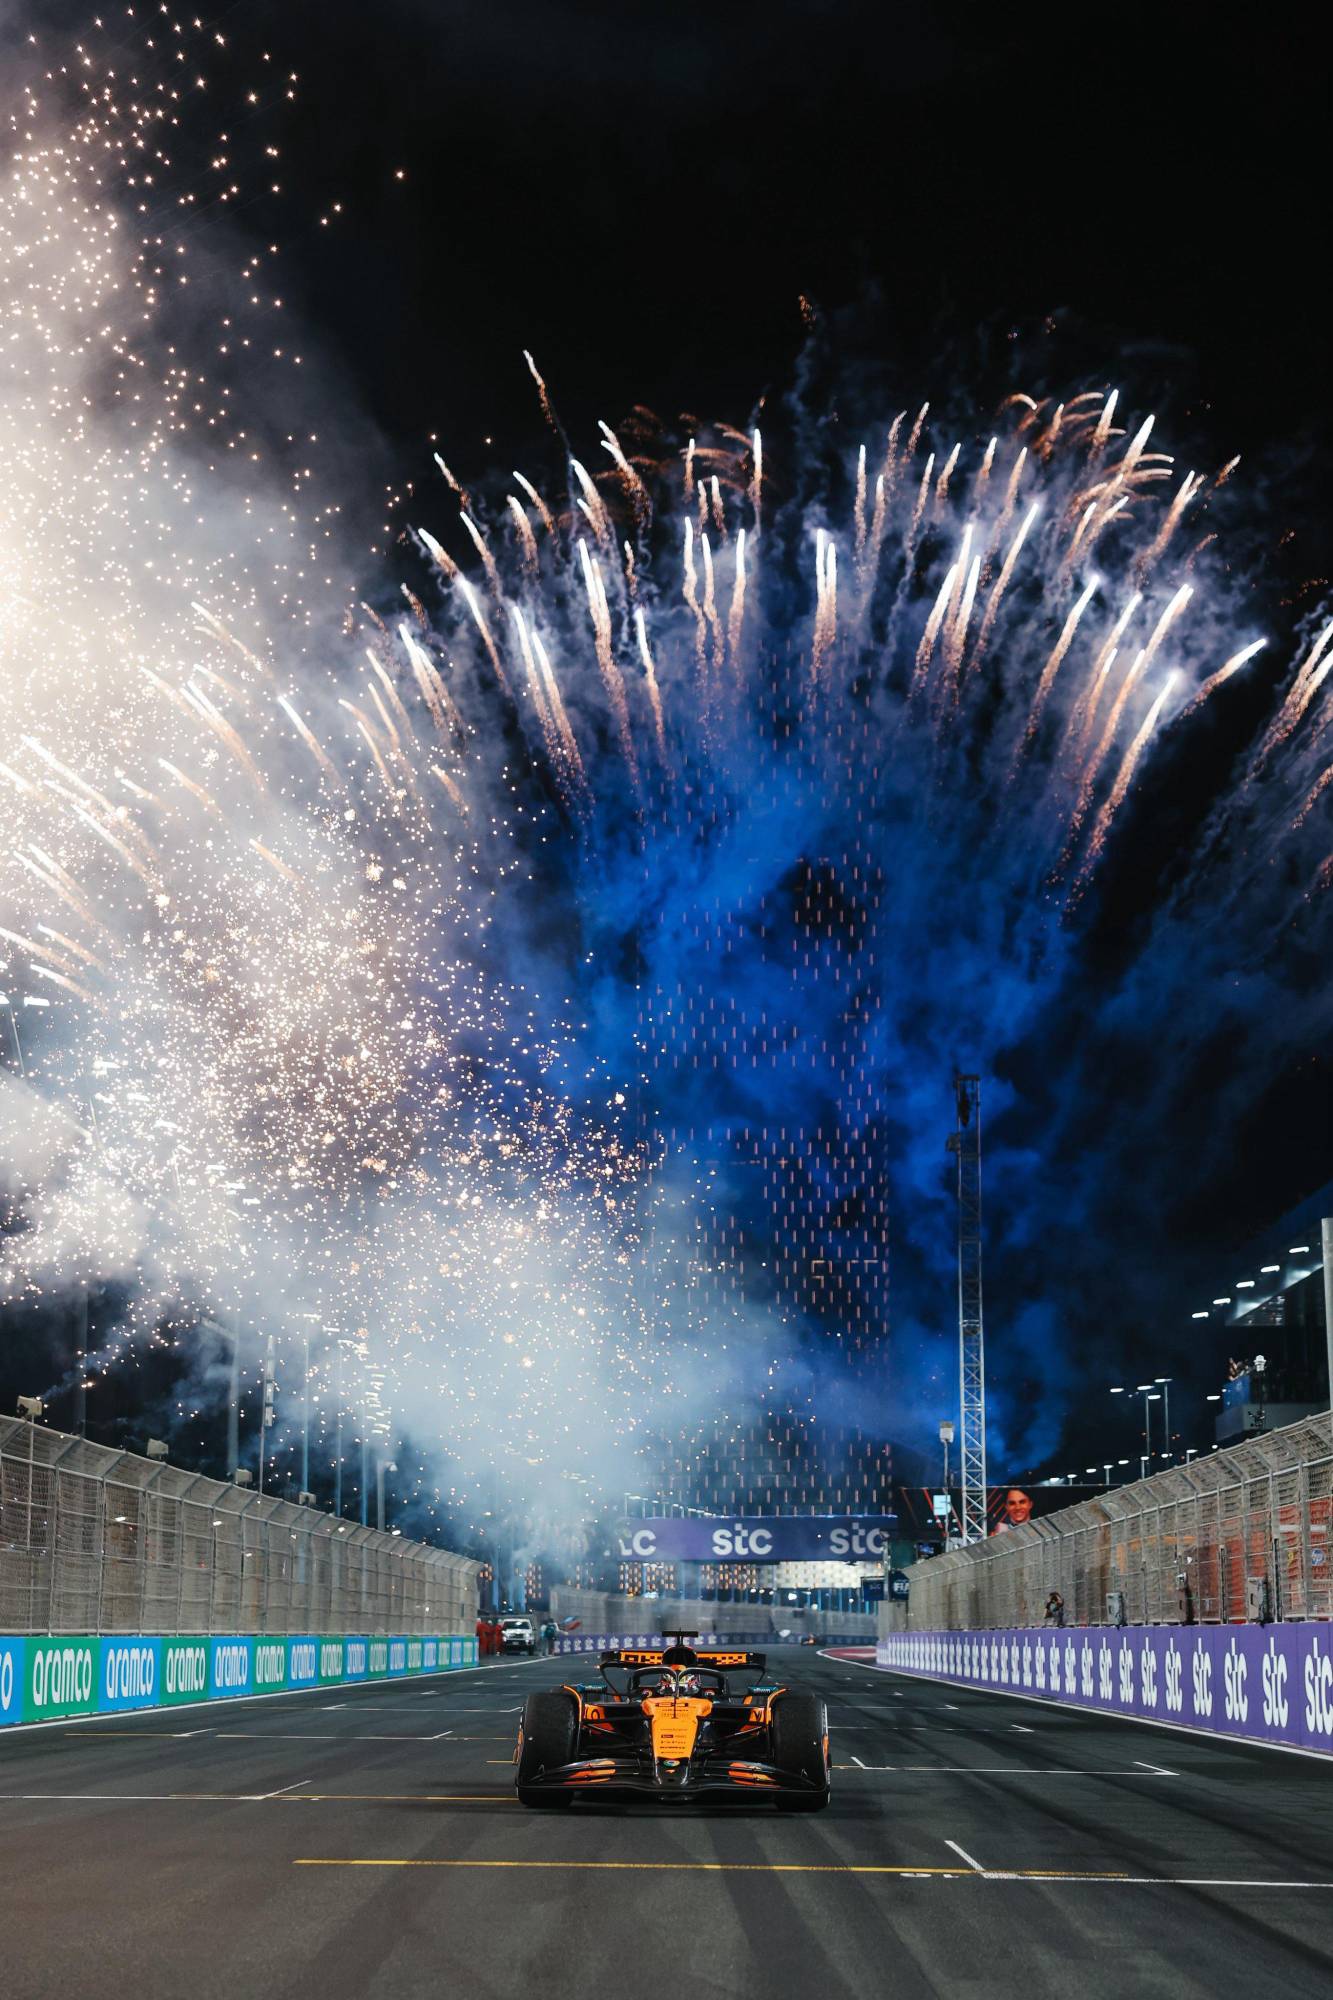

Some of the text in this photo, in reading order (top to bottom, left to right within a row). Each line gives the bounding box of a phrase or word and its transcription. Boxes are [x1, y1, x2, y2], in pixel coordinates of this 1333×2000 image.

[712, 1523, 773, 1556] stc
[829, 1521, 890, 1554] stc
[33, 1648, 93, 1706] aramco
[106, 1647, 154, 1699] aramco
[166, 1647, 206, 1693] aramco
[215, 1646, 248, 1687] aramco
[256, 1645, 285, 1683] aramco
[1166, 1637, 1182, 1712] stc
[1193, 1637, 1212, 1717] stc
[1225, 1637, 1249, 1722] stc
[1263, 1637, 1288, 1728] stc
[1305, 1637, 1333, 1735] stc
